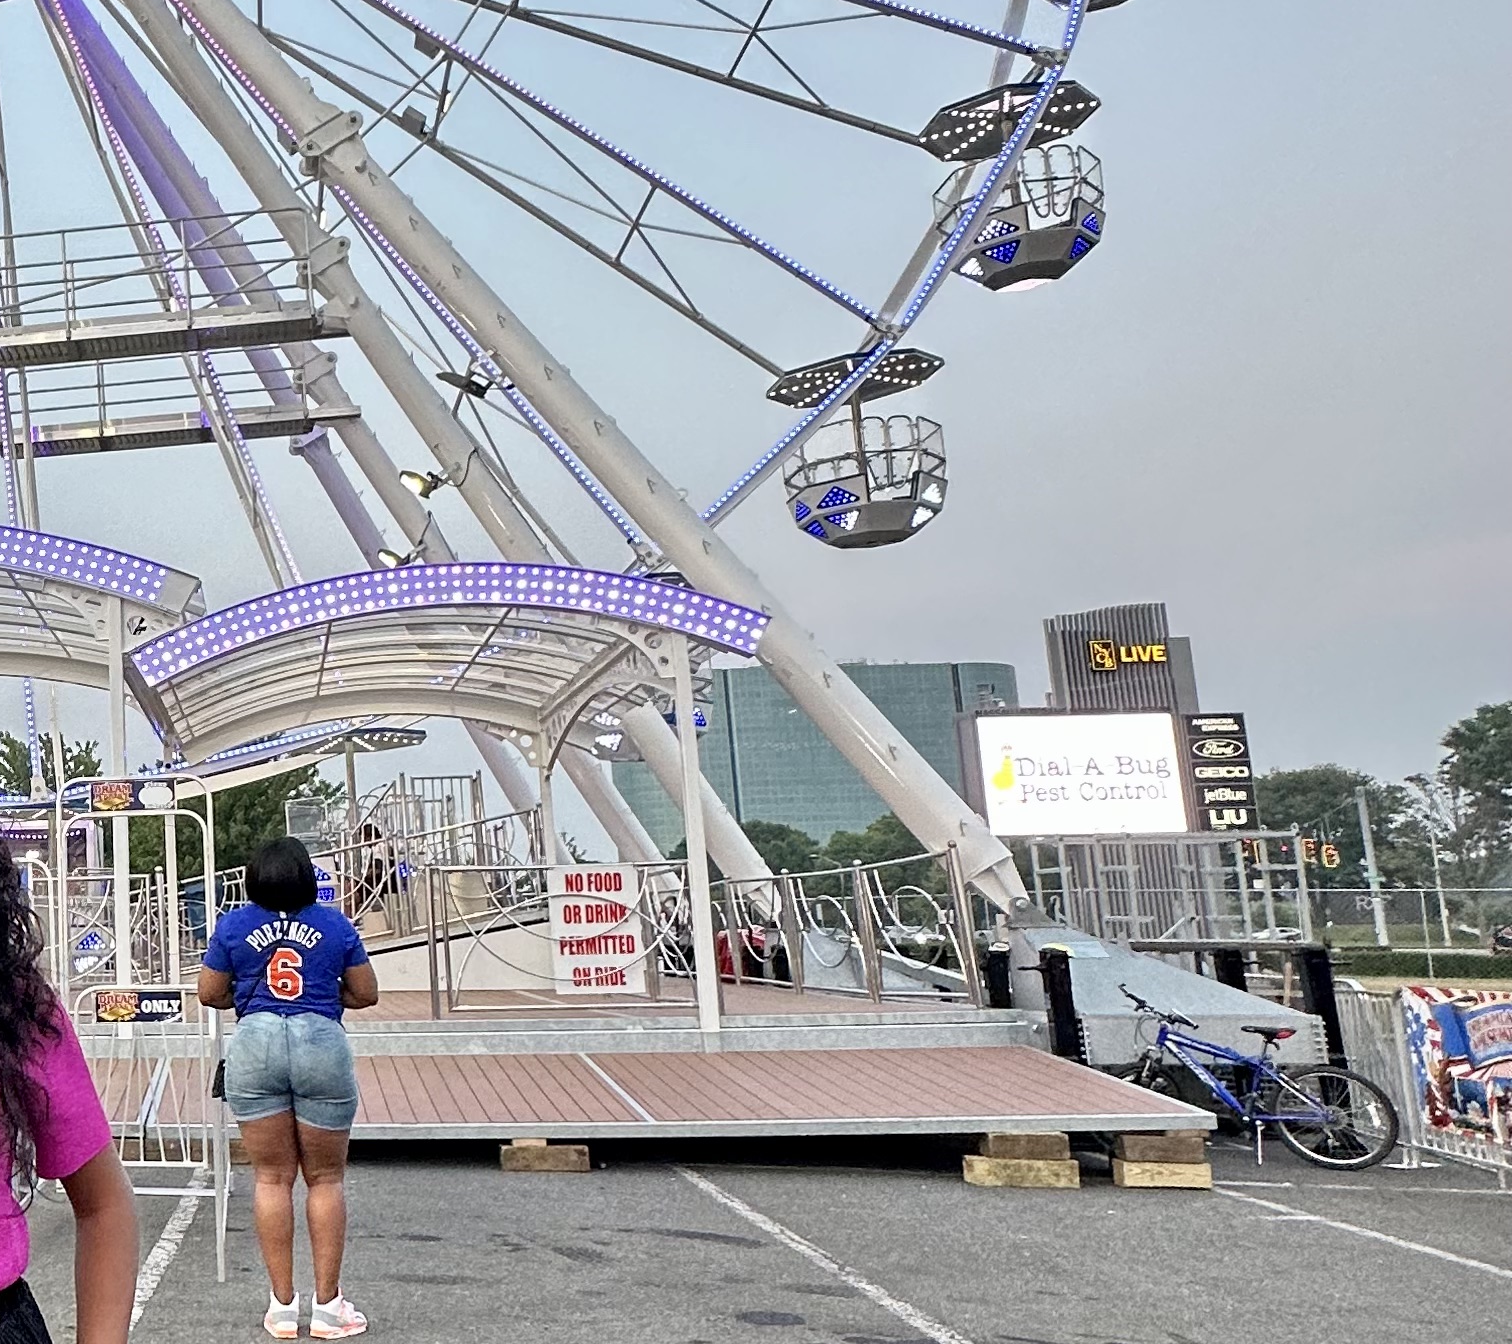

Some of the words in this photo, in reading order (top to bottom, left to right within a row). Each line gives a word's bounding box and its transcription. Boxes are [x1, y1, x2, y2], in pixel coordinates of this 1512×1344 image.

[1120, 644, 1167, 663] LIVE
[1202, 741, 1234, 755] Ford
[1194, 766, 1249, 778] GEICO
[1020, 783, 1070, 803] Pest
[1079, 780, 1168, 802] Control
[1209, 808, 1248, 825] LIU
[564, 873, 583, 892] NO
[587, 872, 622, 892] FOOD
[563, 905, 581, 924] OR
[586, 903, 628, 924] DRINK
[244, 920, 323, 953] PORZINGIS
[559, 934, 635, 955] PERMITTED
[266, 947, 303, 1001] 6
[573, 967, 591, 987] ON
[595, 966, 627, 986] RIDE
[140, 999, 181, 1013] ONLY
